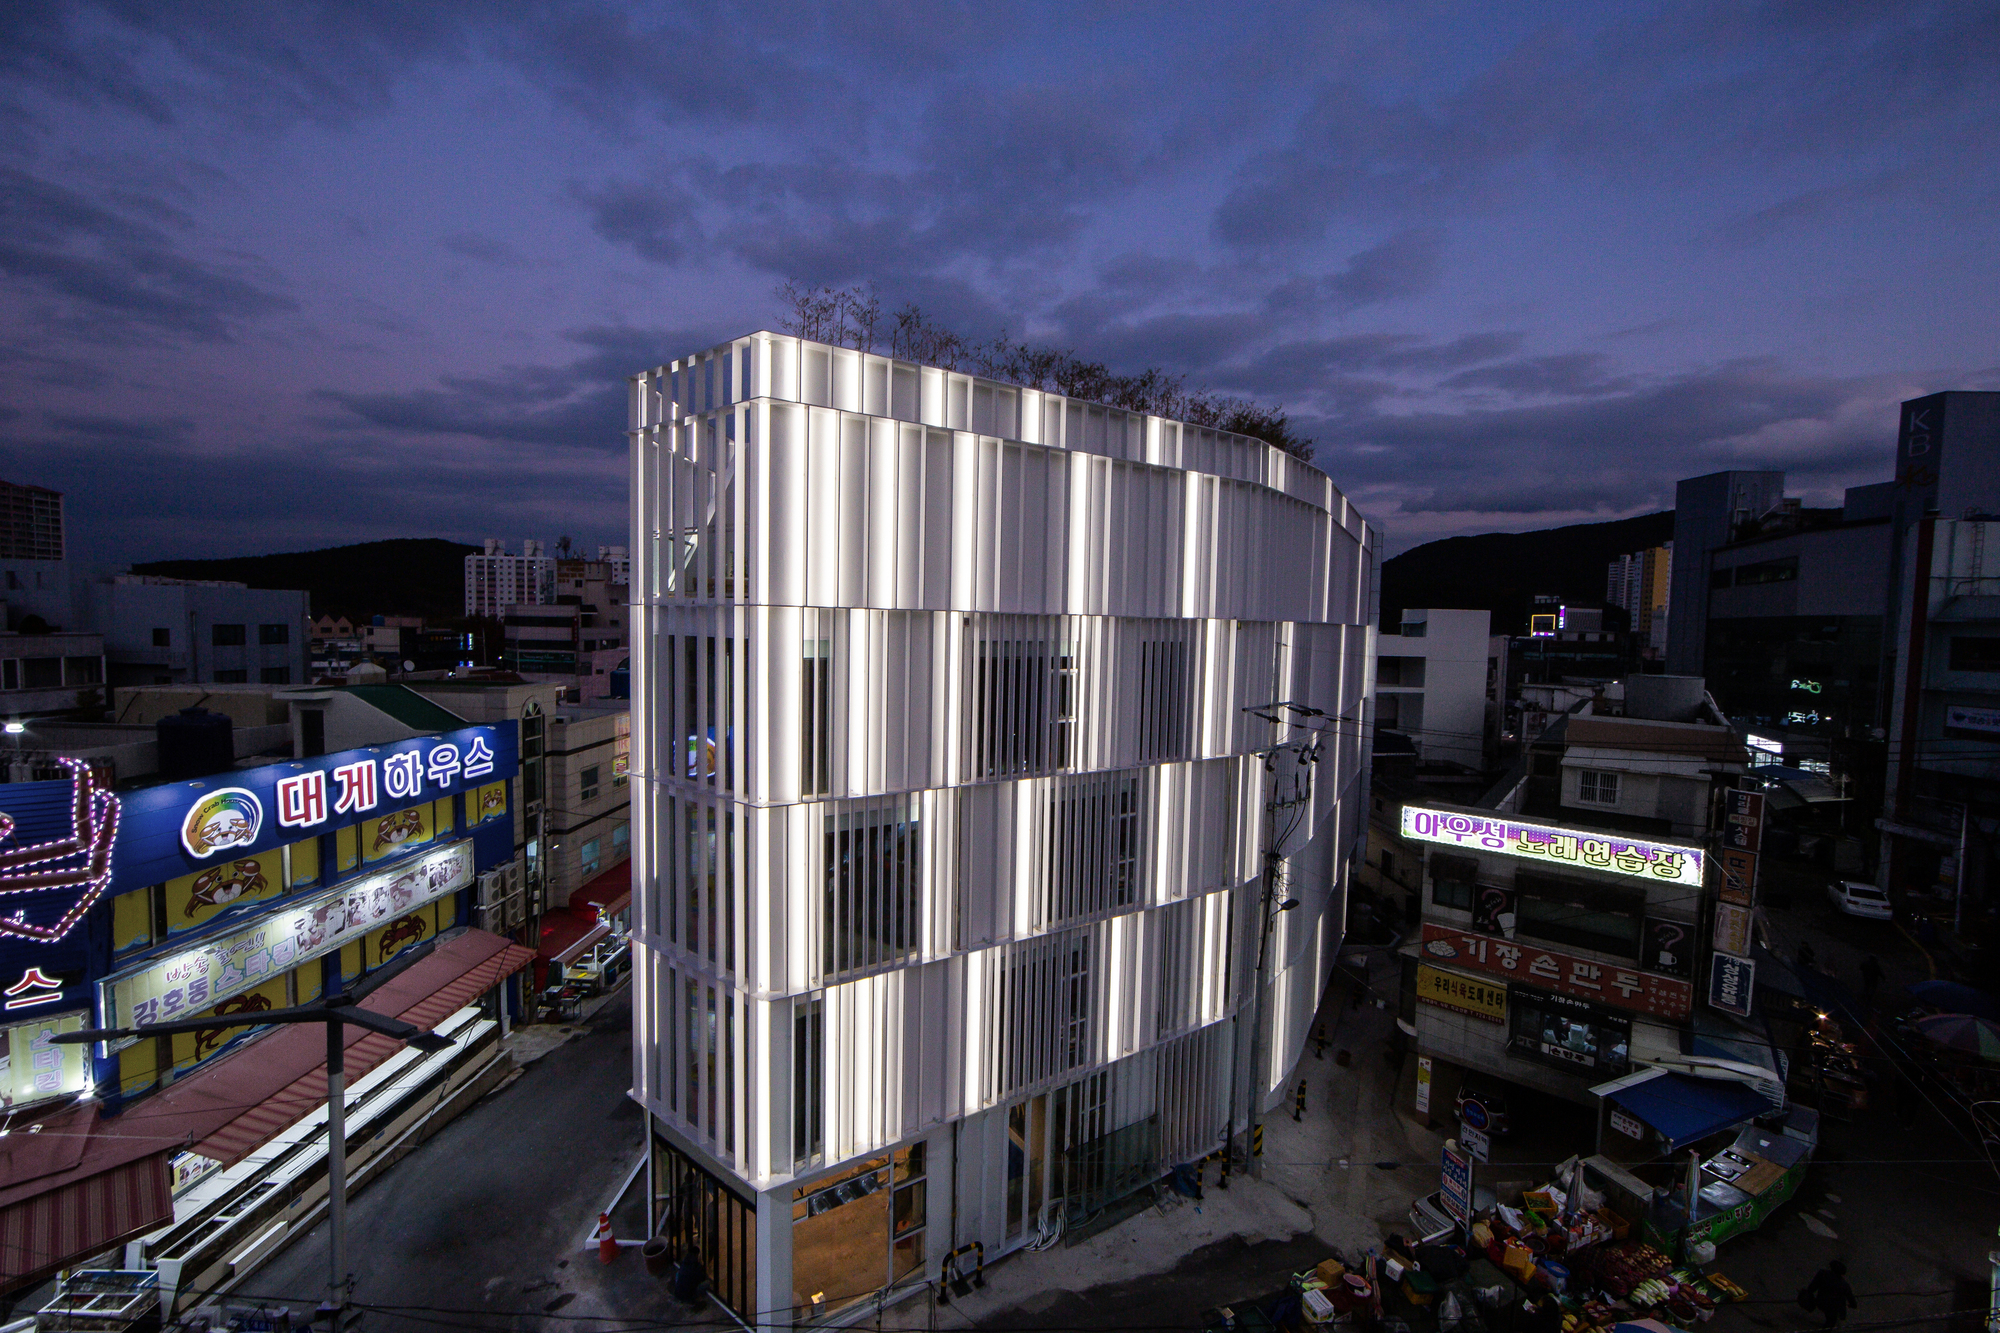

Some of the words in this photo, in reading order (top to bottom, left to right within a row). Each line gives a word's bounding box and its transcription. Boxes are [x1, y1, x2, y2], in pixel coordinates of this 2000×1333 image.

[277, 737, 494, 827] 대게하우스
[190, 812, 205, 834] Snow
[203, 799, 220, 815] Crab
[1414, 812, 1505, 850] 아우성
[1516, 830, 1687, 878] 노래연습장
[4, 968, 63, 1009] 스
[133, 976, 209, 1031] 강호동
[214, 937, 297, 993] 스타킹
[166, 953, 210, 984] 방송
[215, 932, 266, 967] 출연!!
[1461, 937, 1644, 999] 기장손만두
